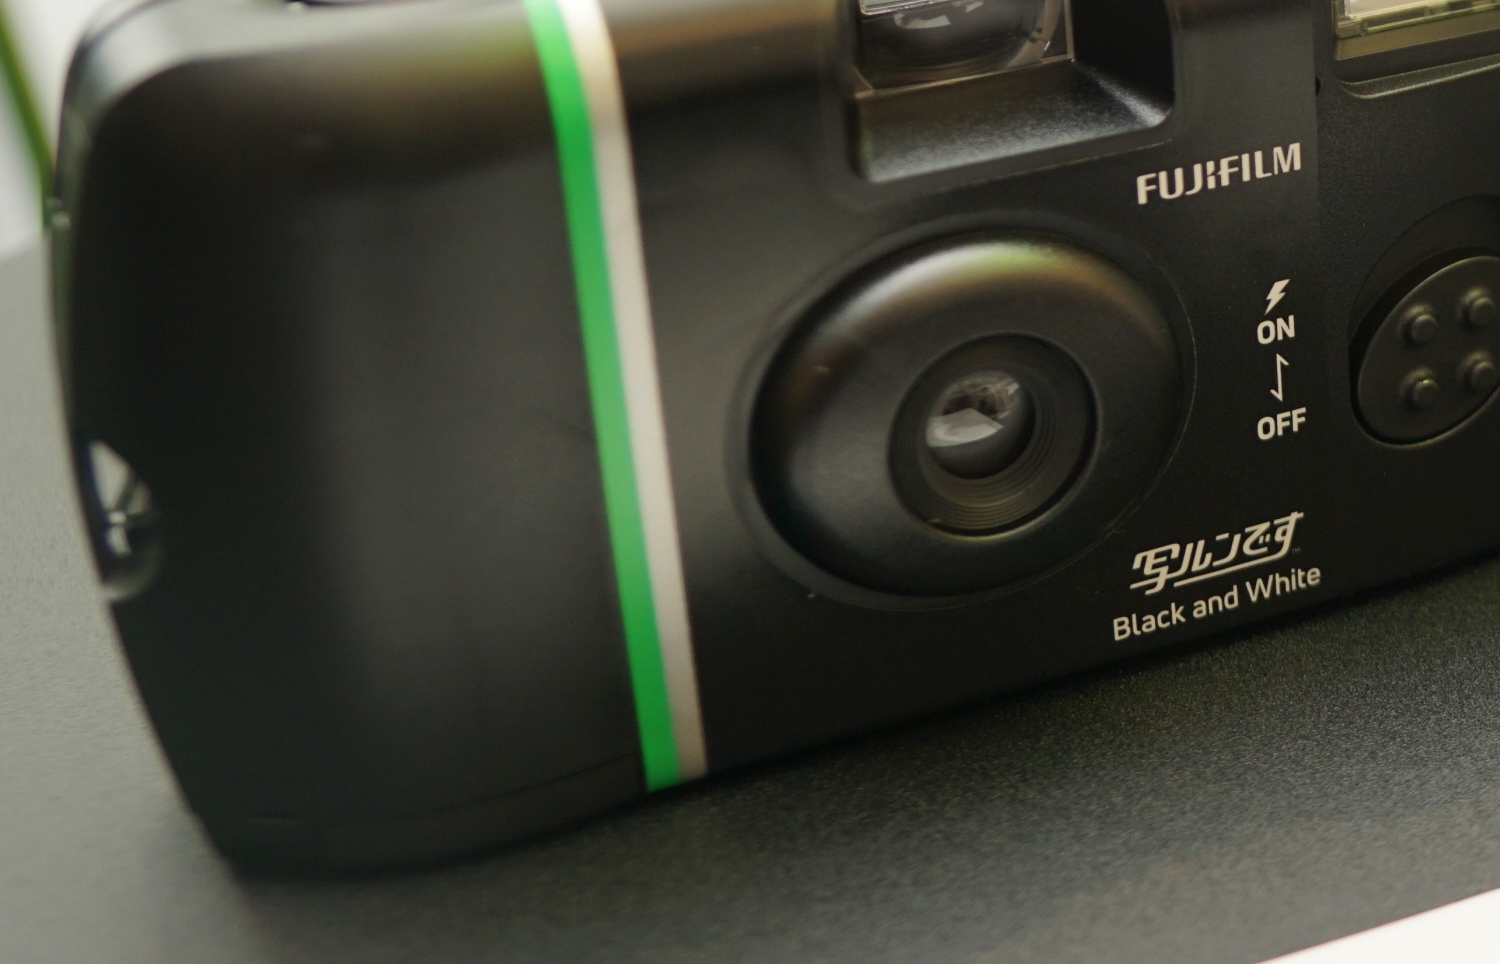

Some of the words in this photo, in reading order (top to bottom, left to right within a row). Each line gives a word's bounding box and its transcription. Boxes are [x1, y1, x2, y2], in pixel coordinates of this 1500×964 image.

[1136, 142, 1302, 206] FUJIFILM
[1256, 315, 1296, 345] ON
[1256, 407, 1307, 441] OFF
[1130, 511, 1304, 595] 写ルンです
[1113, 602, 1187, 642] Black
[1192, 585, 1239, 619] and
[1245, 567, 1321, 603] White
